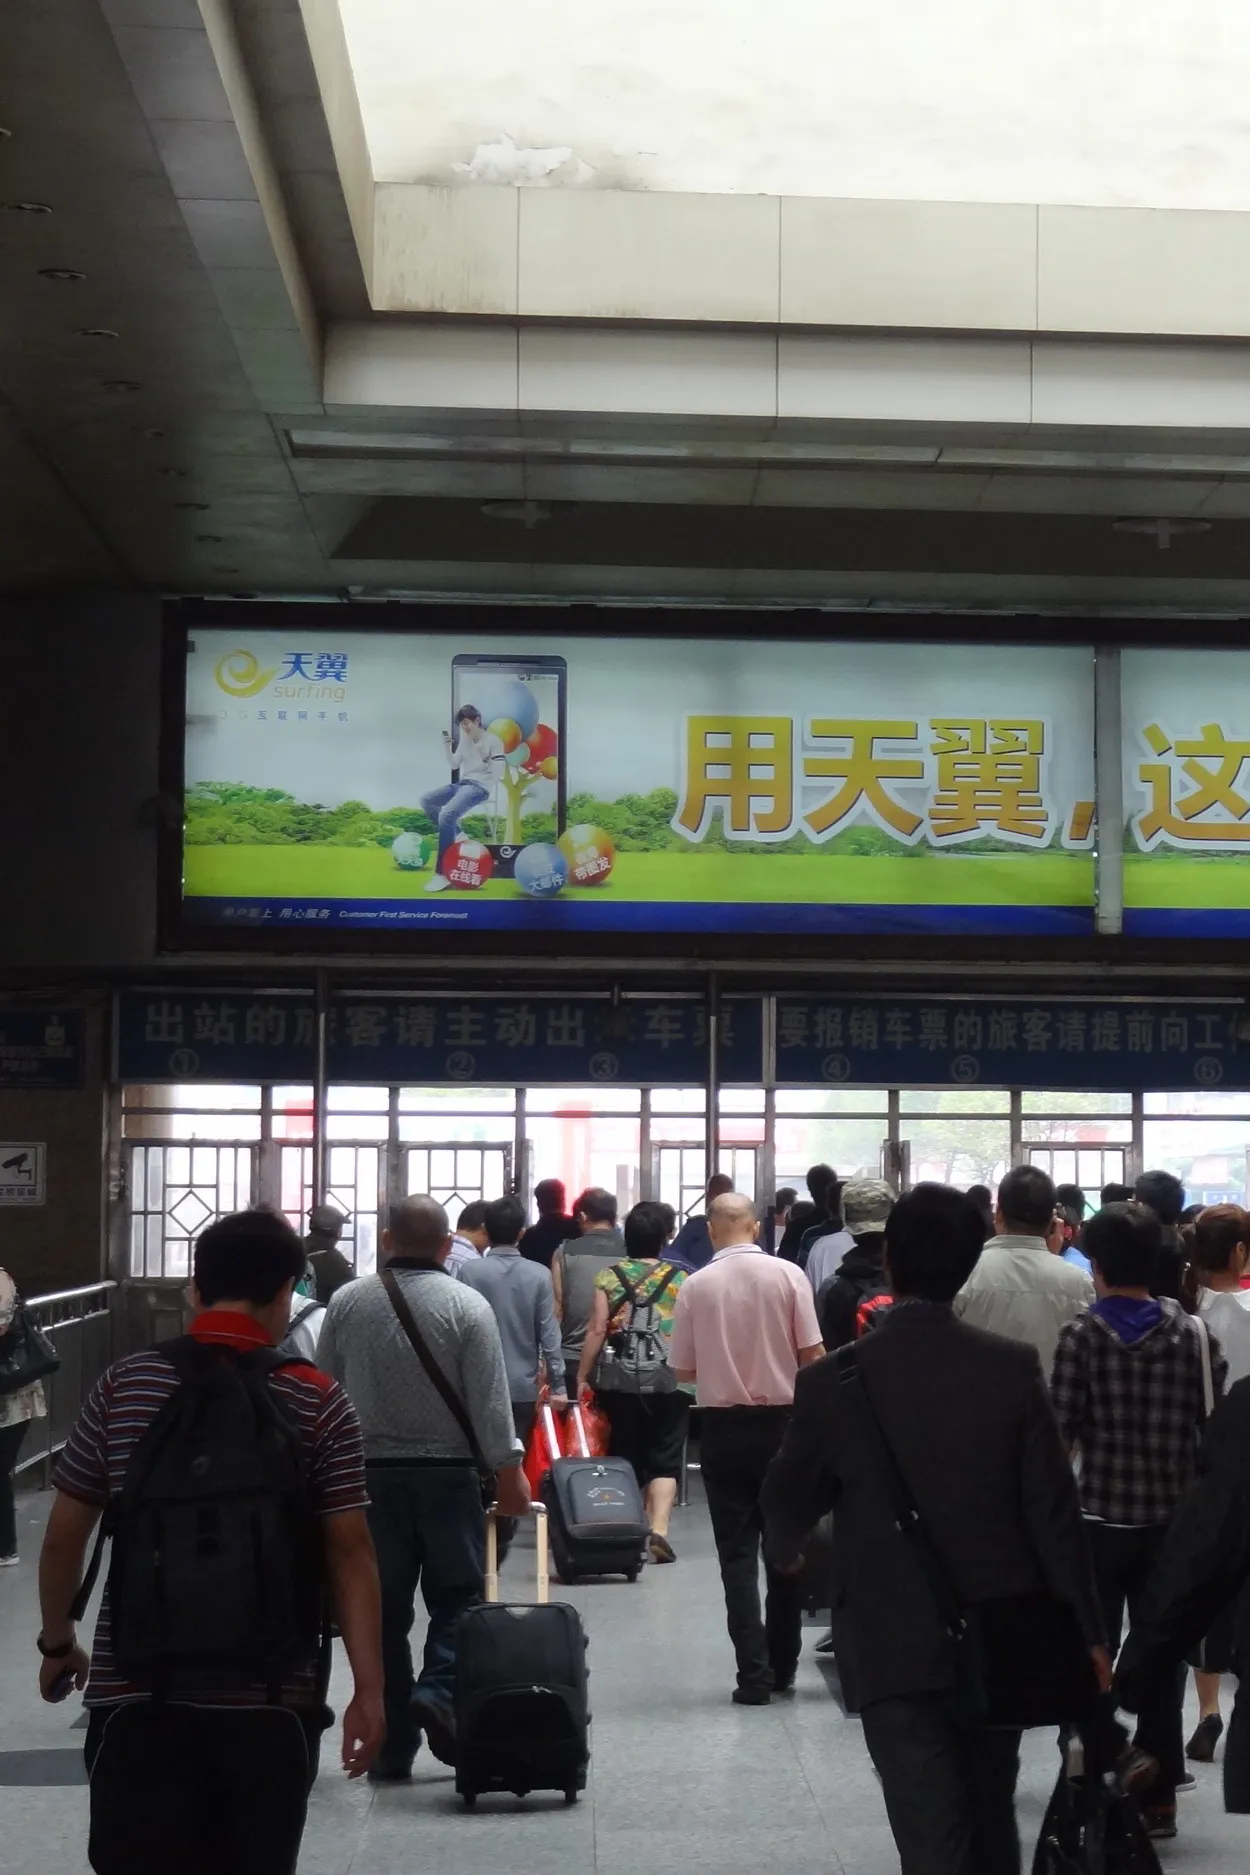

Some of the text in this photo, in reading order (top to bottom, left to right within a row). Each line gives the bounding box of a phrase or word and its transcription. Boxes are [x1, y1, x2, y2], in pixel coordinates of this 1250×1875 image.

[278, 652, 348, 682] 天翼
[274, 684, 345, 702] surfing
[457, 859, 480, 872] 电影
[339, 910, 378, 918] Customer
[379, 910, 398, 918] First
[398, 911, 429, 919] Service
[144, 1000, 735, 1048] 出站的旅客请主动出车票
